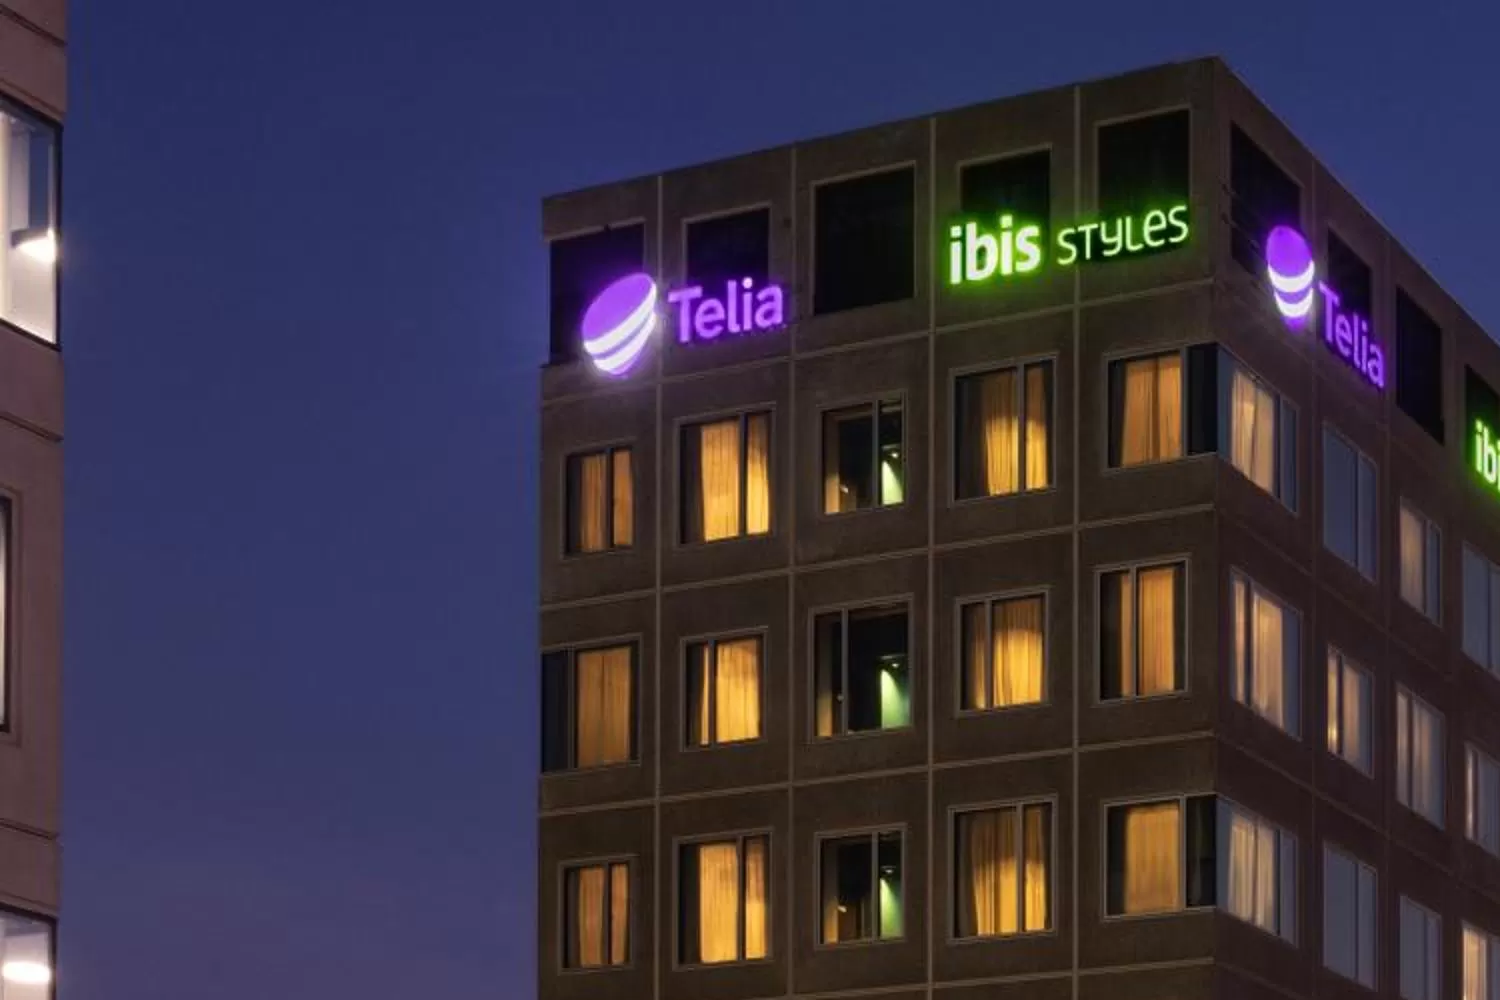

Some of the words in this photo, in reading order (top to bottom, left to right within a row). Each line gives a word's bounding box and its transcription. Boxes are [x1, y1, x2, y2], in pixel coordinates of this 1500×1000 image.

[951, 214, 1042, 284] ibis
[668, 276, 783, 343] Telia
[1319, 281, 1384, 387] Telia
